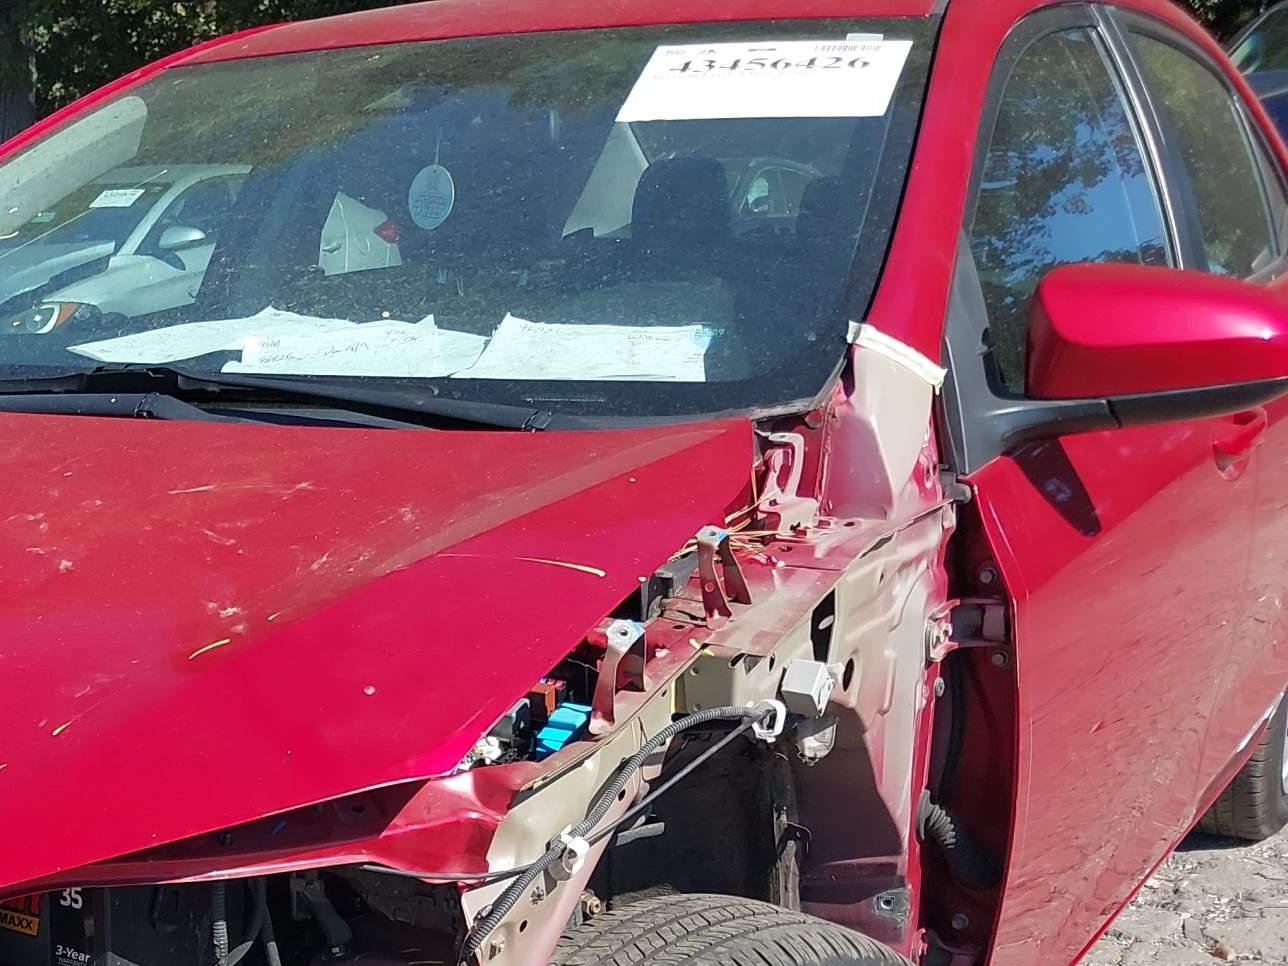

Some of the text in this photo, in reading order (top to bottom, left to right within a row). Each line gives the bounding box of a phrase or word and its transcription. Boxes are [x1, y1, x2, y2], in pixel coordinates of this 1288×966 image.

[668, 55, 872, 73] 43456426
[59, 887, 83, 910] 35
[55, 944, 91, 963] 3-Year
